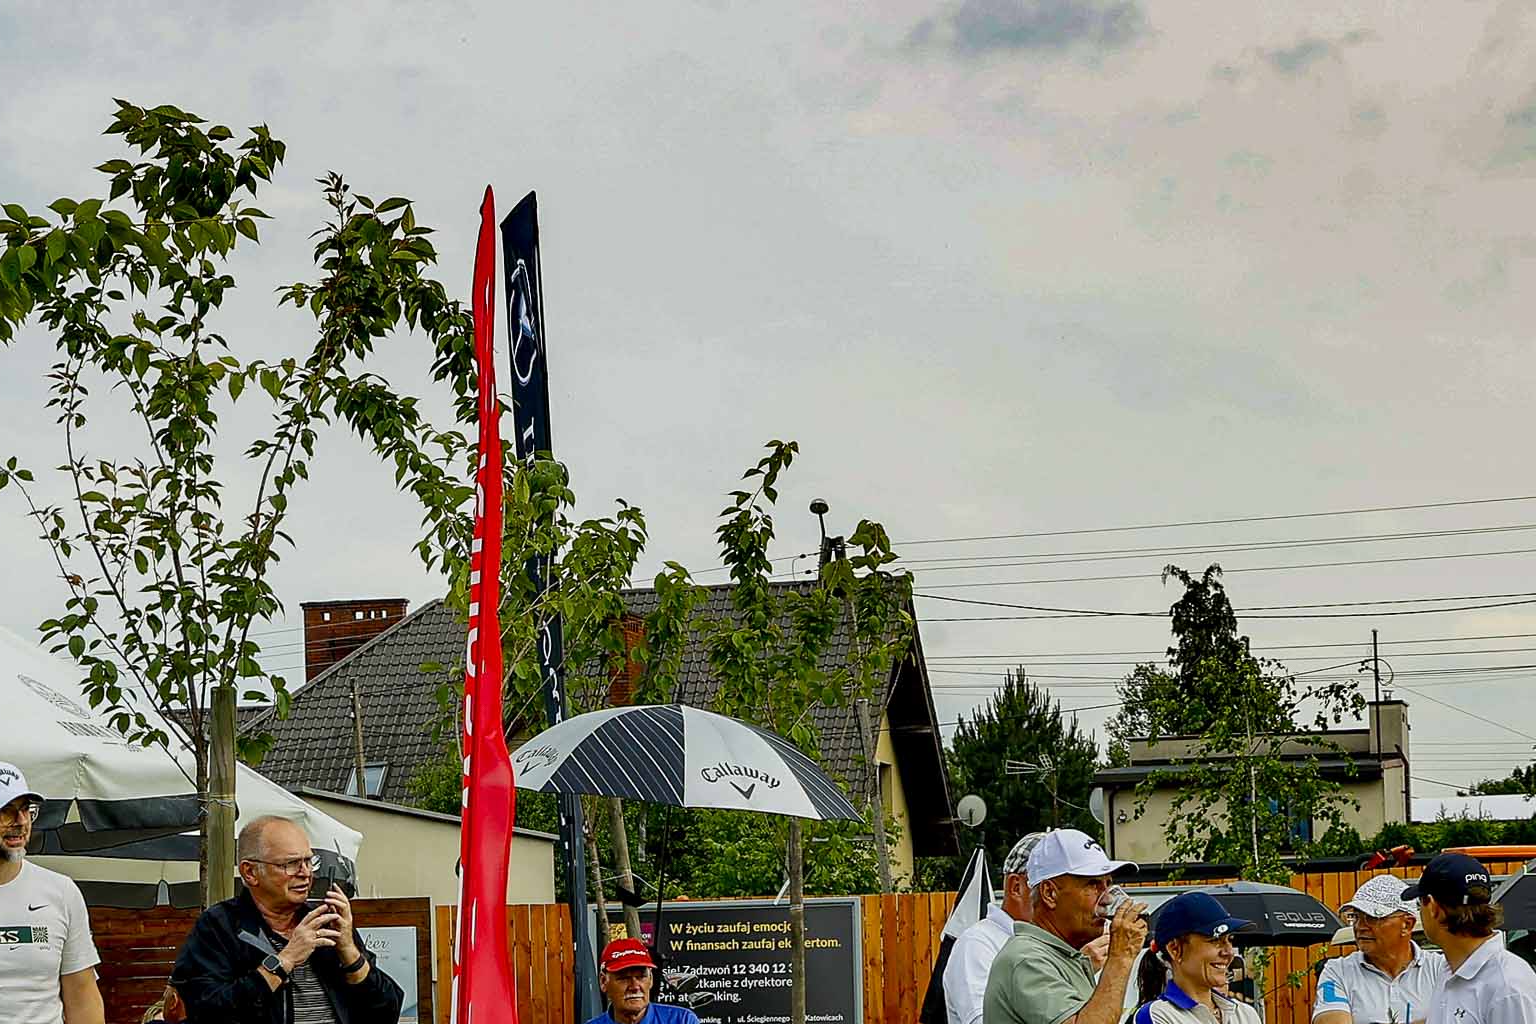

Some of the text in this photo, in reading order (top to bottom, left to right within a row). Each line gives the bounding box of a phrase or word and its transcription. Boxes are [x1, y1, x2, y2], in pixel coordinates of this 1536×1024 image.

[701, 762, 781, 789] Callaway
[1465, 873, 1487, 883] ping
[669, 924, 683, 935] W
[685, 922, 715, 936] życiu
[717, 921, 751, 935] zaufaj
[670, 937, 841, 951] W finansach zaufaj ekertom.
[682, 963, 731, 976] Zadzwoń
[733, 964, 747, 974] 12
[748, 963, 770, 974] 340
[772, 963, 787, 973] 12
[733, 980, 740, 988] z
[741, 976, 793, 990] dyrektore
